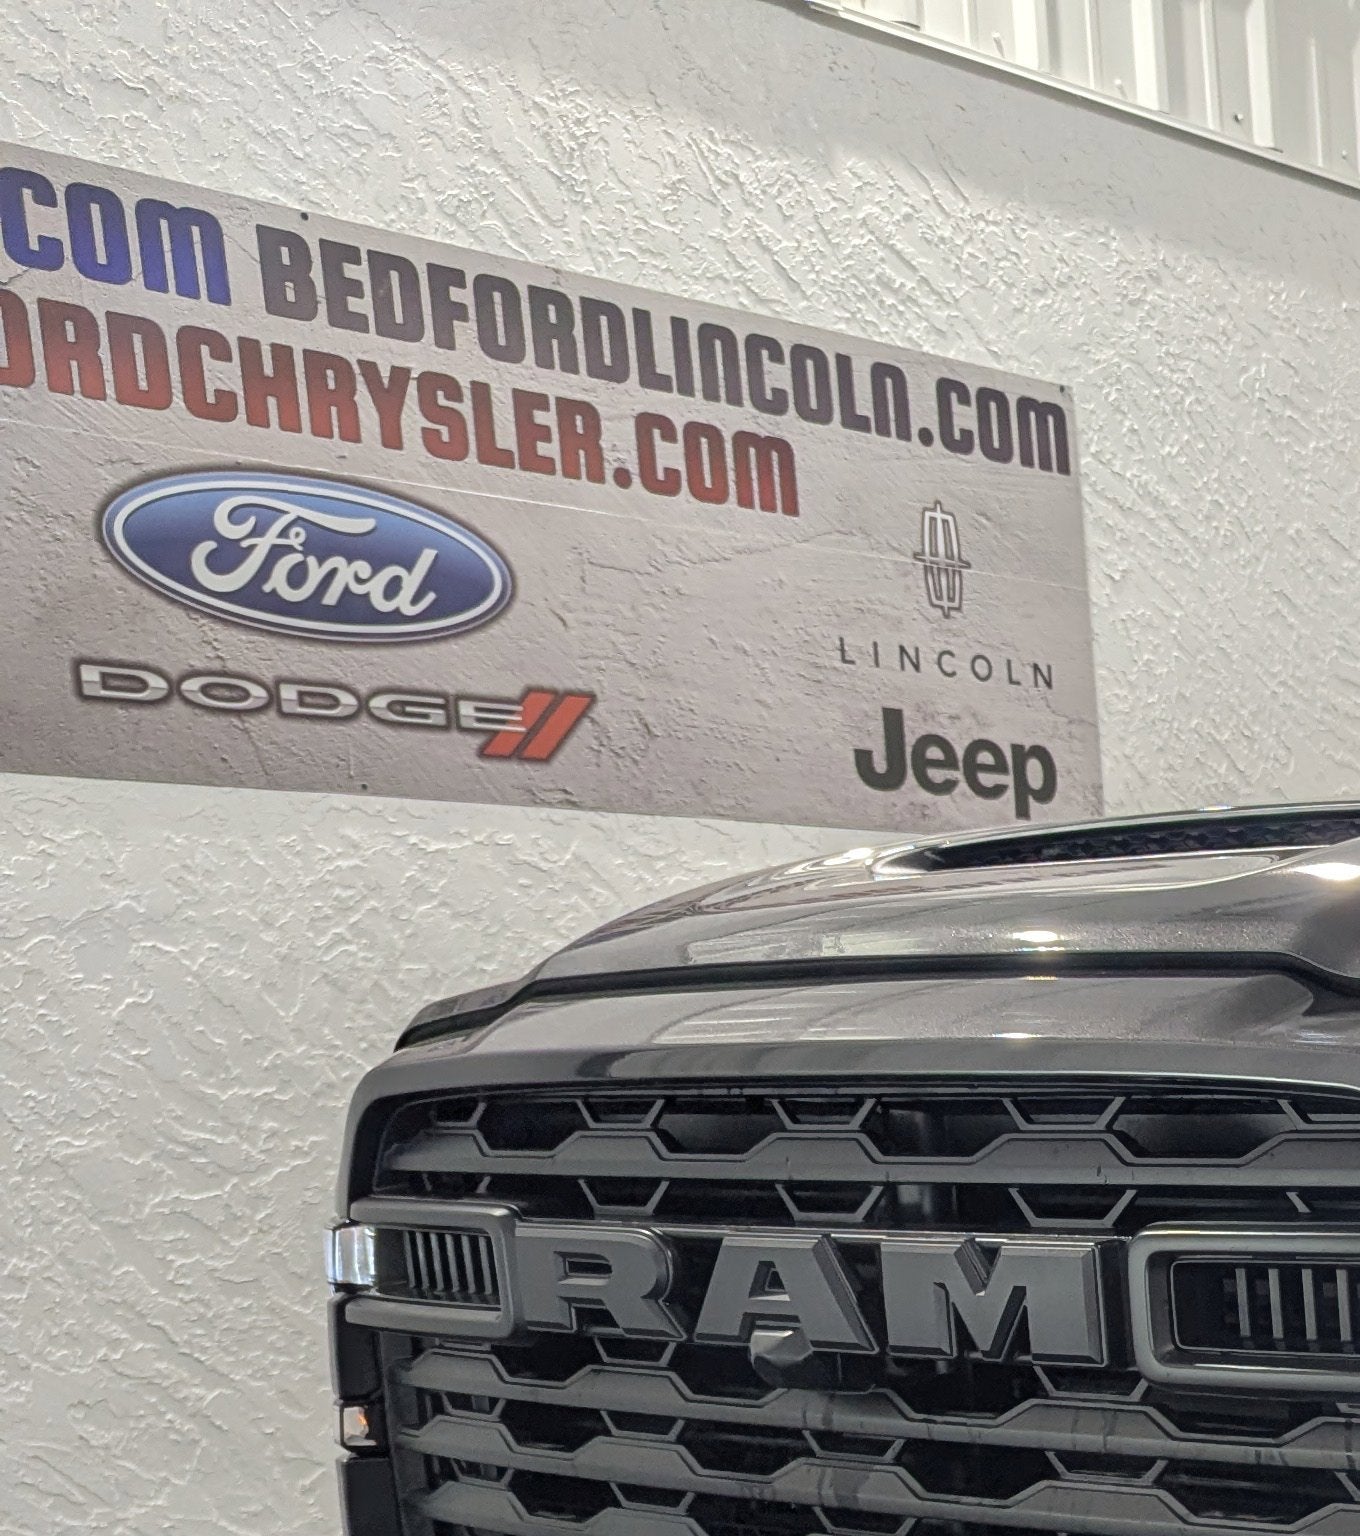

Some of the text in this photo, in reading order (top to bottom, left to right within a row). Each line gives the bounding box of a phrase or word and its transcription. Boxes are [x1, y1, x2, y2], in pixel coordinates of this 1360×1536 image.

[256, 224, 1071, 476] BEDFORDLINCOLN.COM
[191, 496, 437, 616] Ford
[79, 663, 527, 733] DODGE
[837, 636, 1053, 690] LINCOLN
[853, 706, 1058, 821] Jeep
[515, 1223, 1108, 1367] RAM
